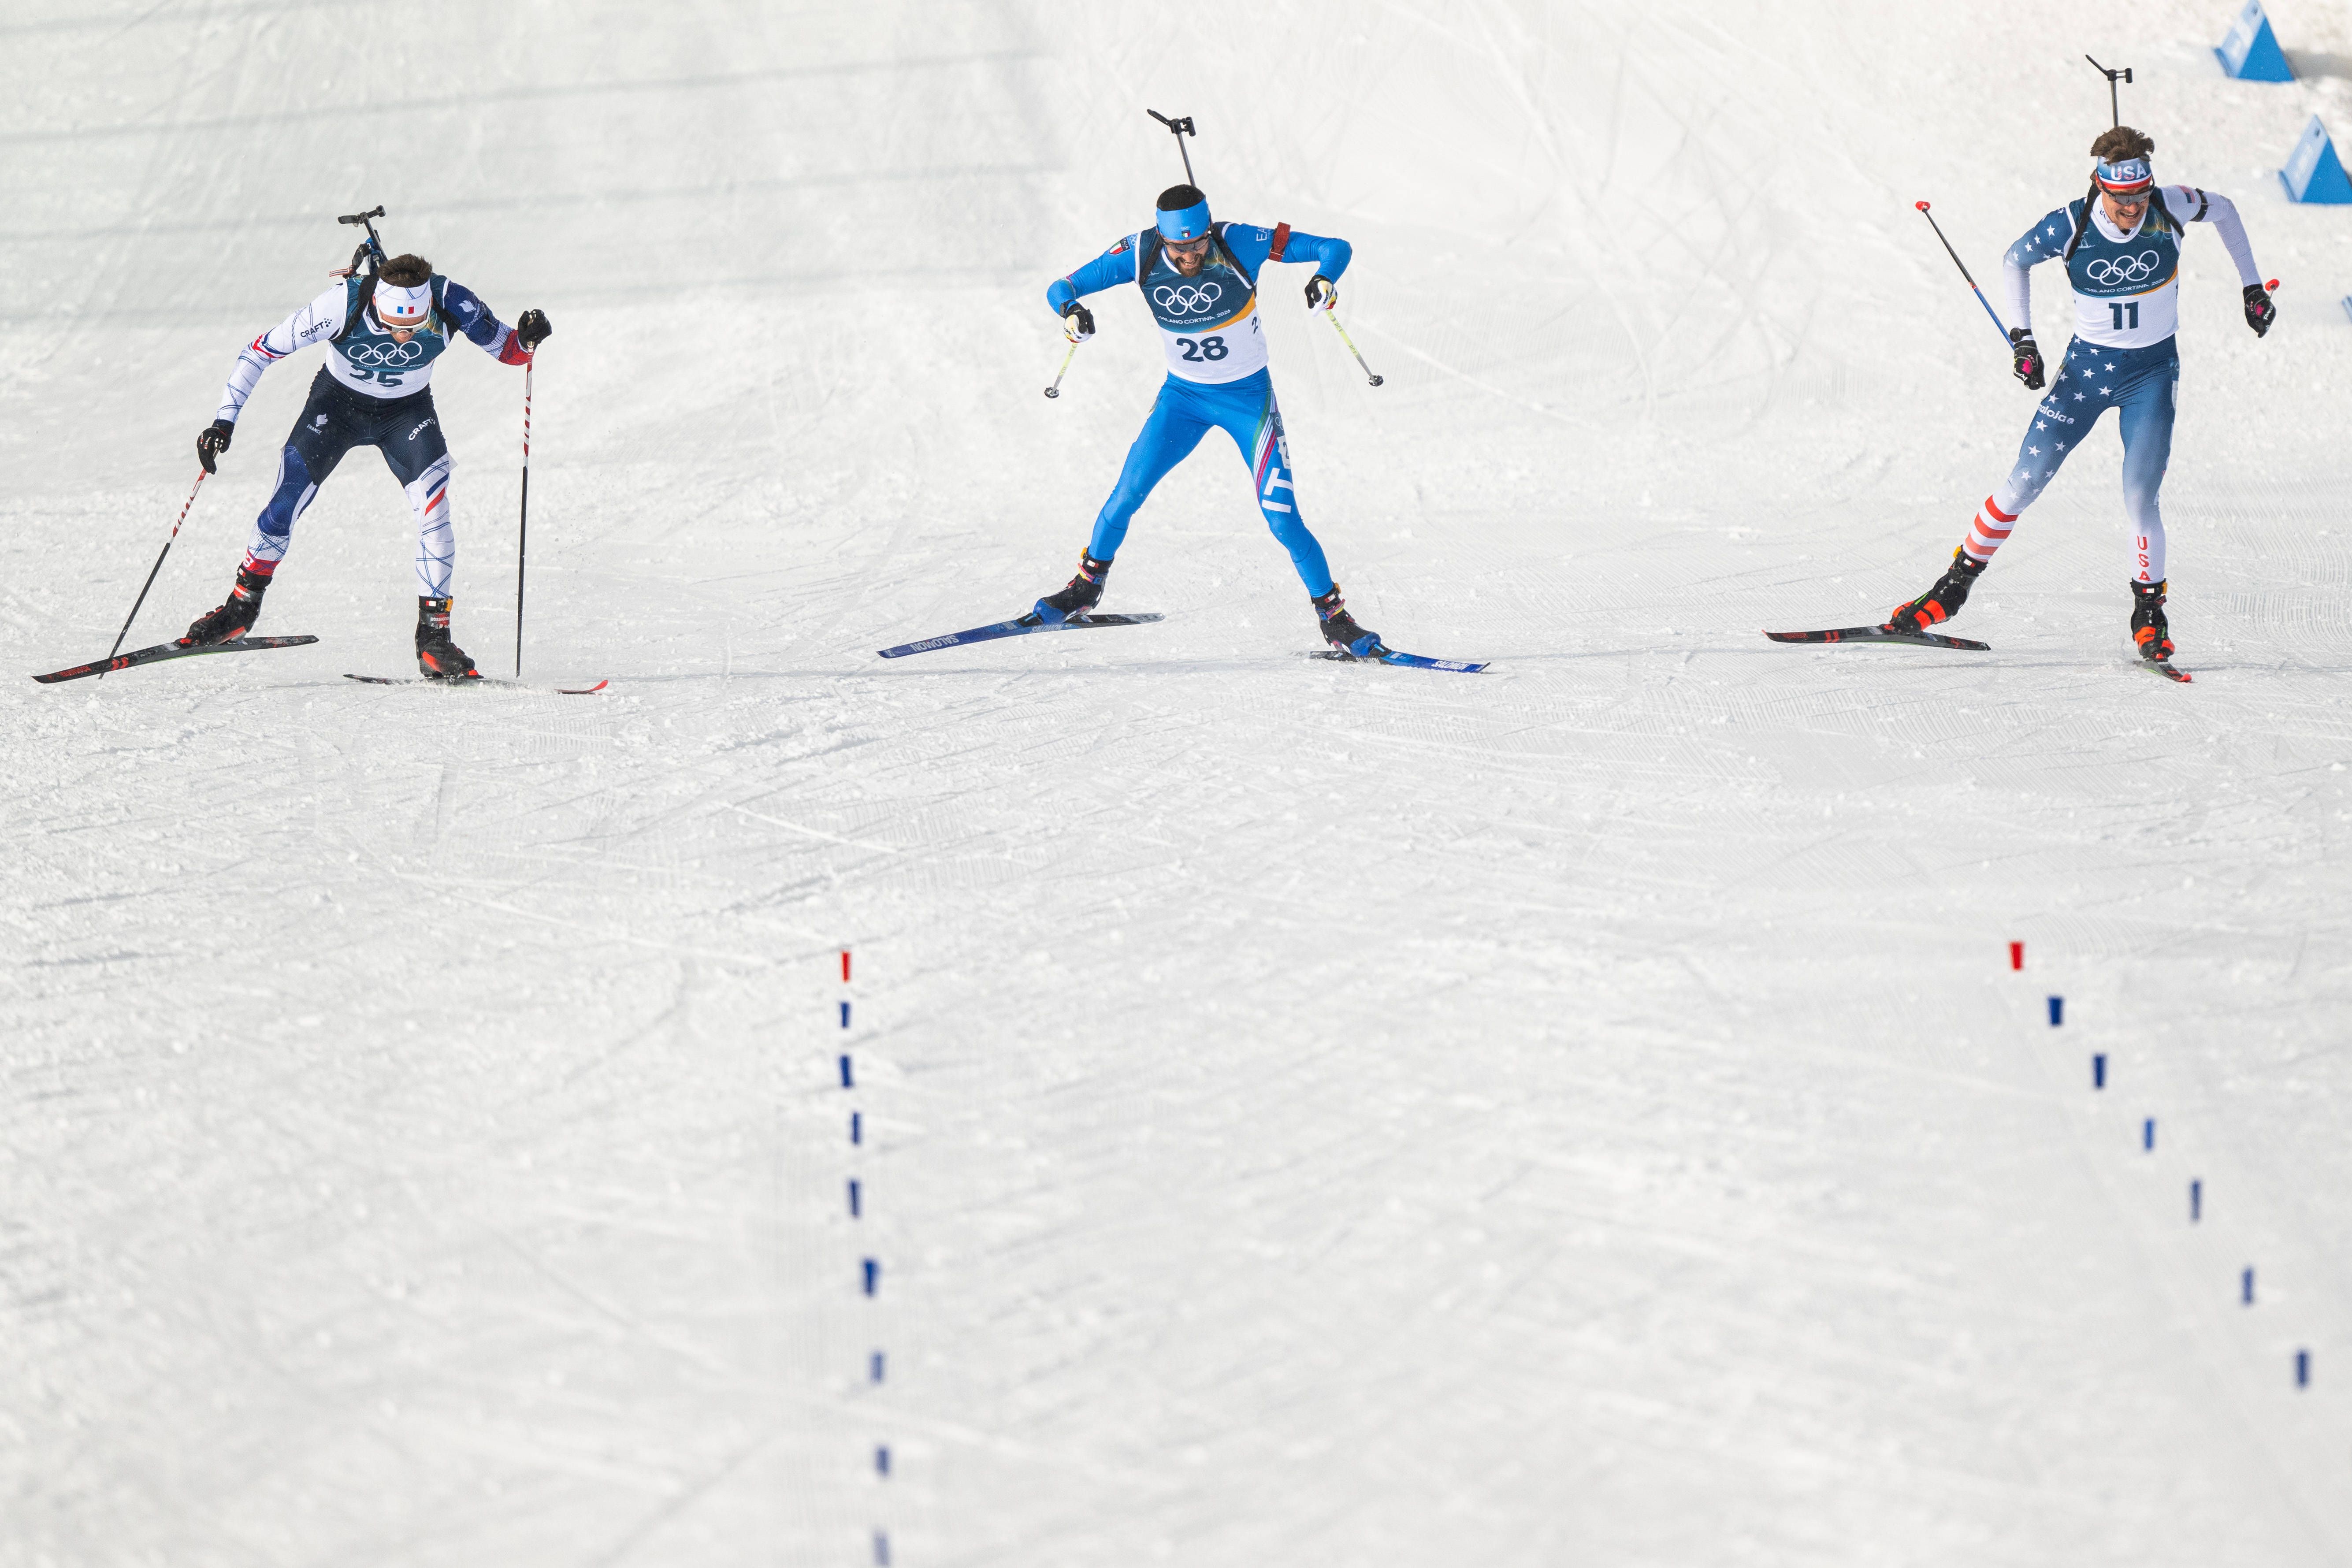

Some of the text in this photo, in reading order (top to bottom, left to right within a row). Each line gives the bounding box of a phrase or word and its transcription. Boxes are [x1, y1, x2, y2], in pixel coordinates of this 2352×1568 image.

[2111, 163, 2147, 181] USA
[1256, 227, 1267, 242] EA
[1158, 309, 1231, 324] MILANO CORTINA 2026
[2108, 301, 2139, 330] 11
[300, 321, 323, 338] CRAFT
[1176, 336, 1229, 362] 28
[349, 364, 405, 387] 25
[306, 424, 323, 435] FRANCE
[408, 418, 433, 441] CRAFT
[2137, 535, 2151, 581] USA
[1031, 624, 1063, 633] SALOMON
[910, 635, 959, 652] SALOMON
[1431, 660, 1470, 670] SALOMON
